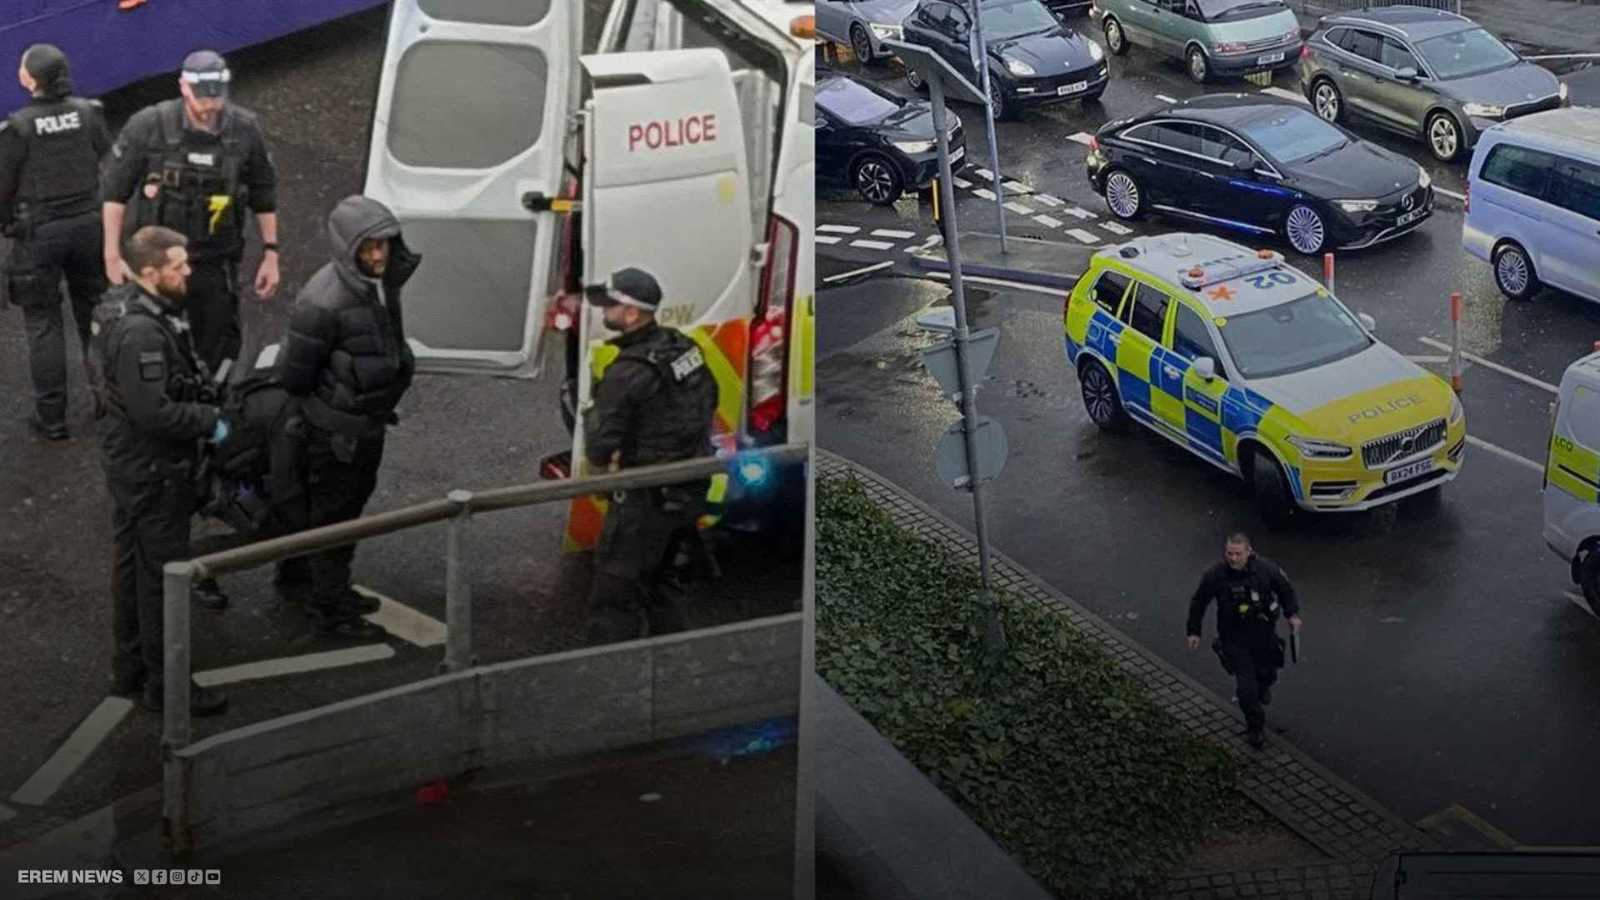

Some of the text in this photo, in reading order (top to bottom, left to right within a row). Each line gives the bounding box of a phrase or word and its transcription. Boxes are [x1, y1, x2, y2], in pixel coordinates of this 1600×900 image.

[34, 111, 80, 135] POLICE
[628, 114, 716, 152] POLICE
[208, 195, 230, 235] 7
[1347, 392, 1423, 424] POLICE
